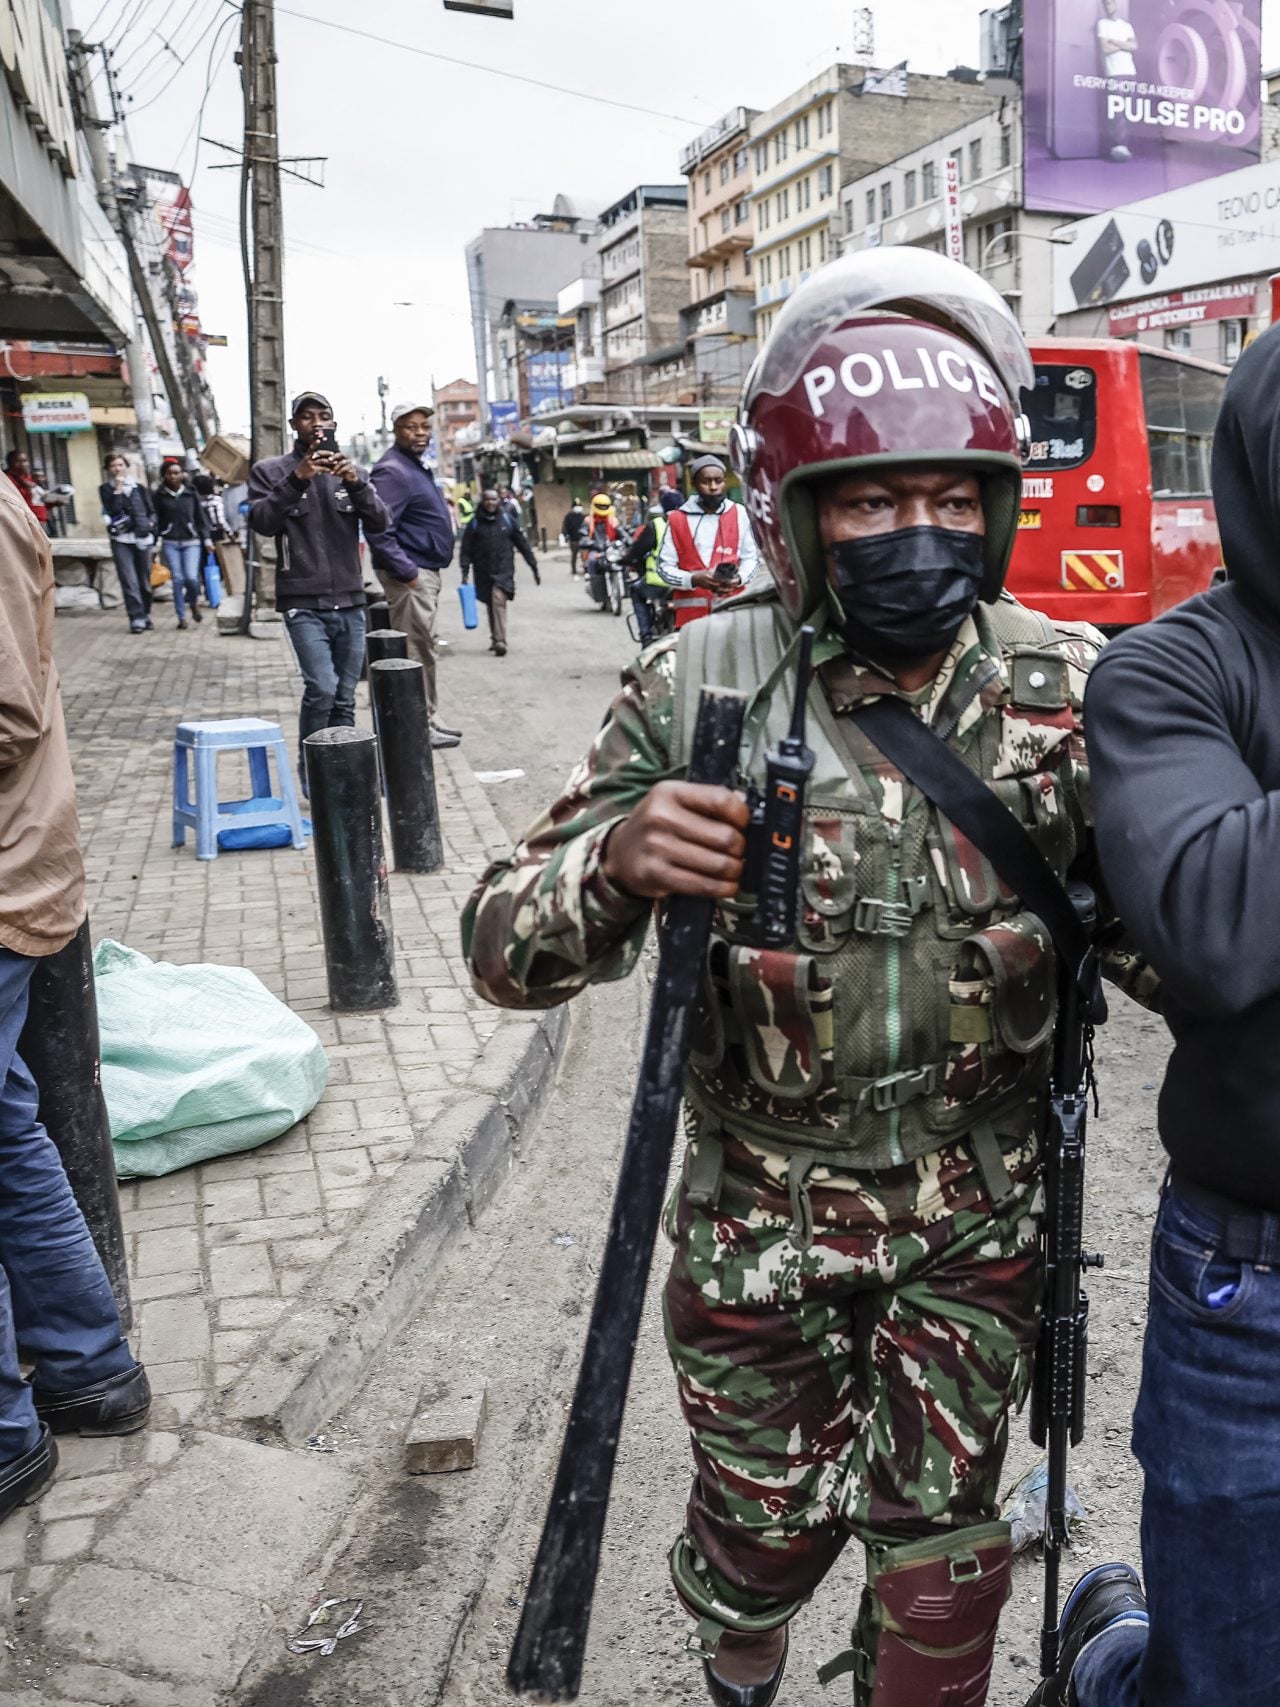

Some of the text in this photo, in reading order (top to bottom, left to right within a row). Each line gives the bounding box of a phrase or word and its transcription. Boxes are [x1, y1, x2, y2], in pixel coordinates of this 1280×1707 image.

[1073, 74, 1106, 90] EVERY
[1107, 78, 1136, 93] SHOT
[1137, 81, 1148, 95] IS
[1107, 94, 1246, 135] PULSE PRO
[1218, 191, 1261, 221] TECNO
[950, 223, 961, 261] HOU
[803, 347, 1001, 418] POLICE
